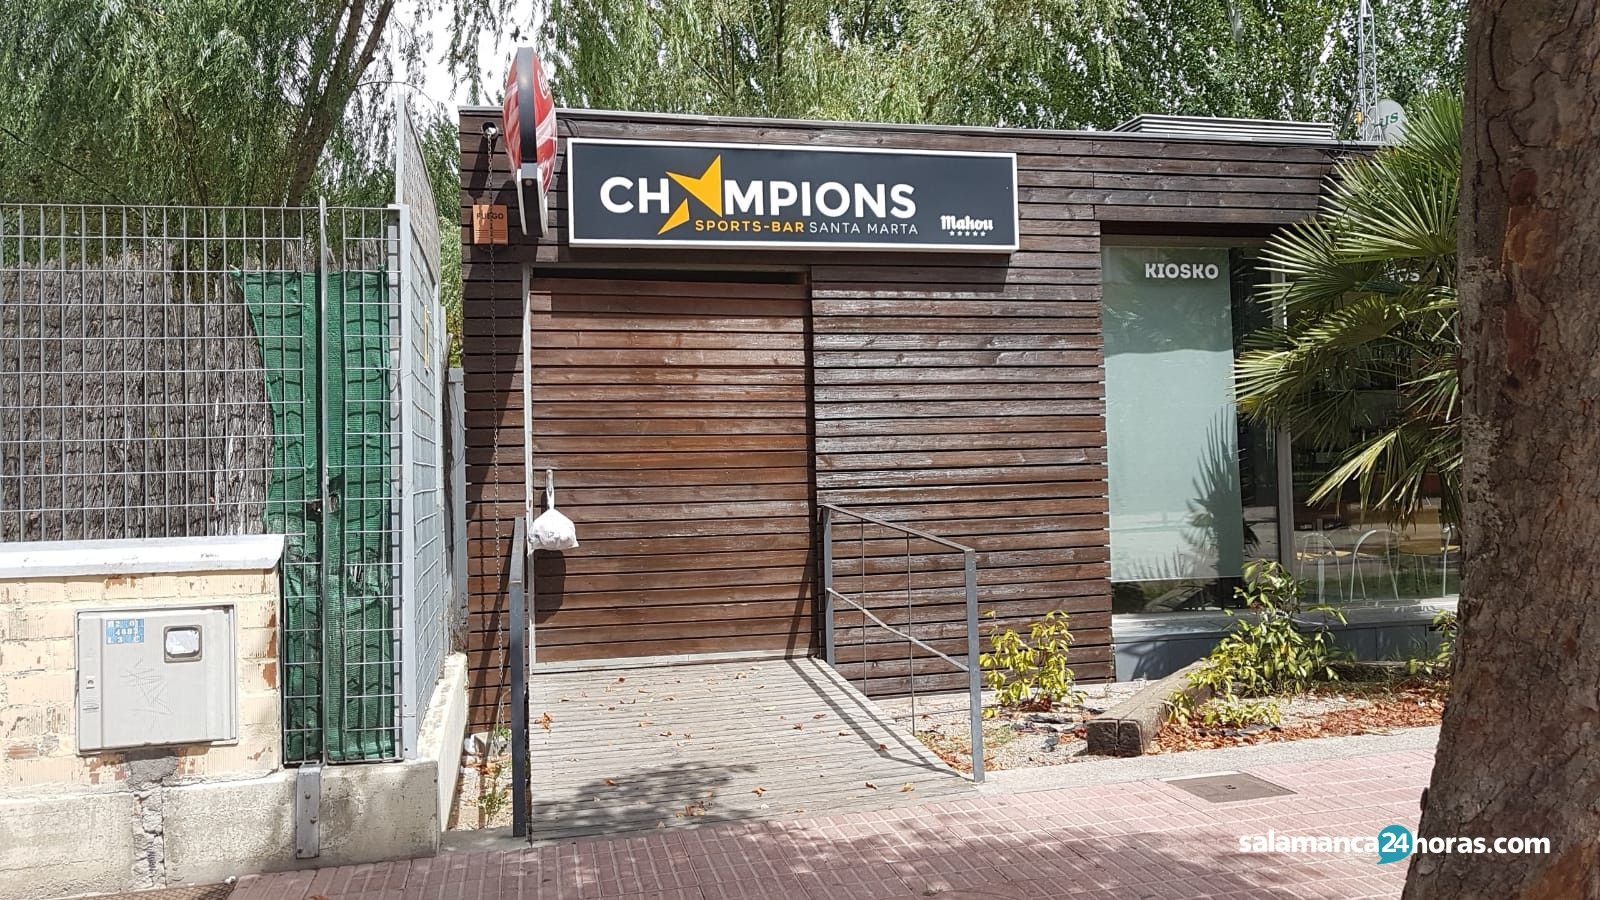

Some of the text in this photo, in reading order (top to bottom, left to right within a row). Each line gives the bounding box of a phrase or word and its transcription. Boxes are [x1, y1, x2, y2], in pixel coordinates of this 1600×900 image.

[695, 219, 919, 235] SPORTS-BAR SANTA MARTA
[940, 215, 994, 231] Mahou
[1145, 263, 1219, 280] KIOSKO
